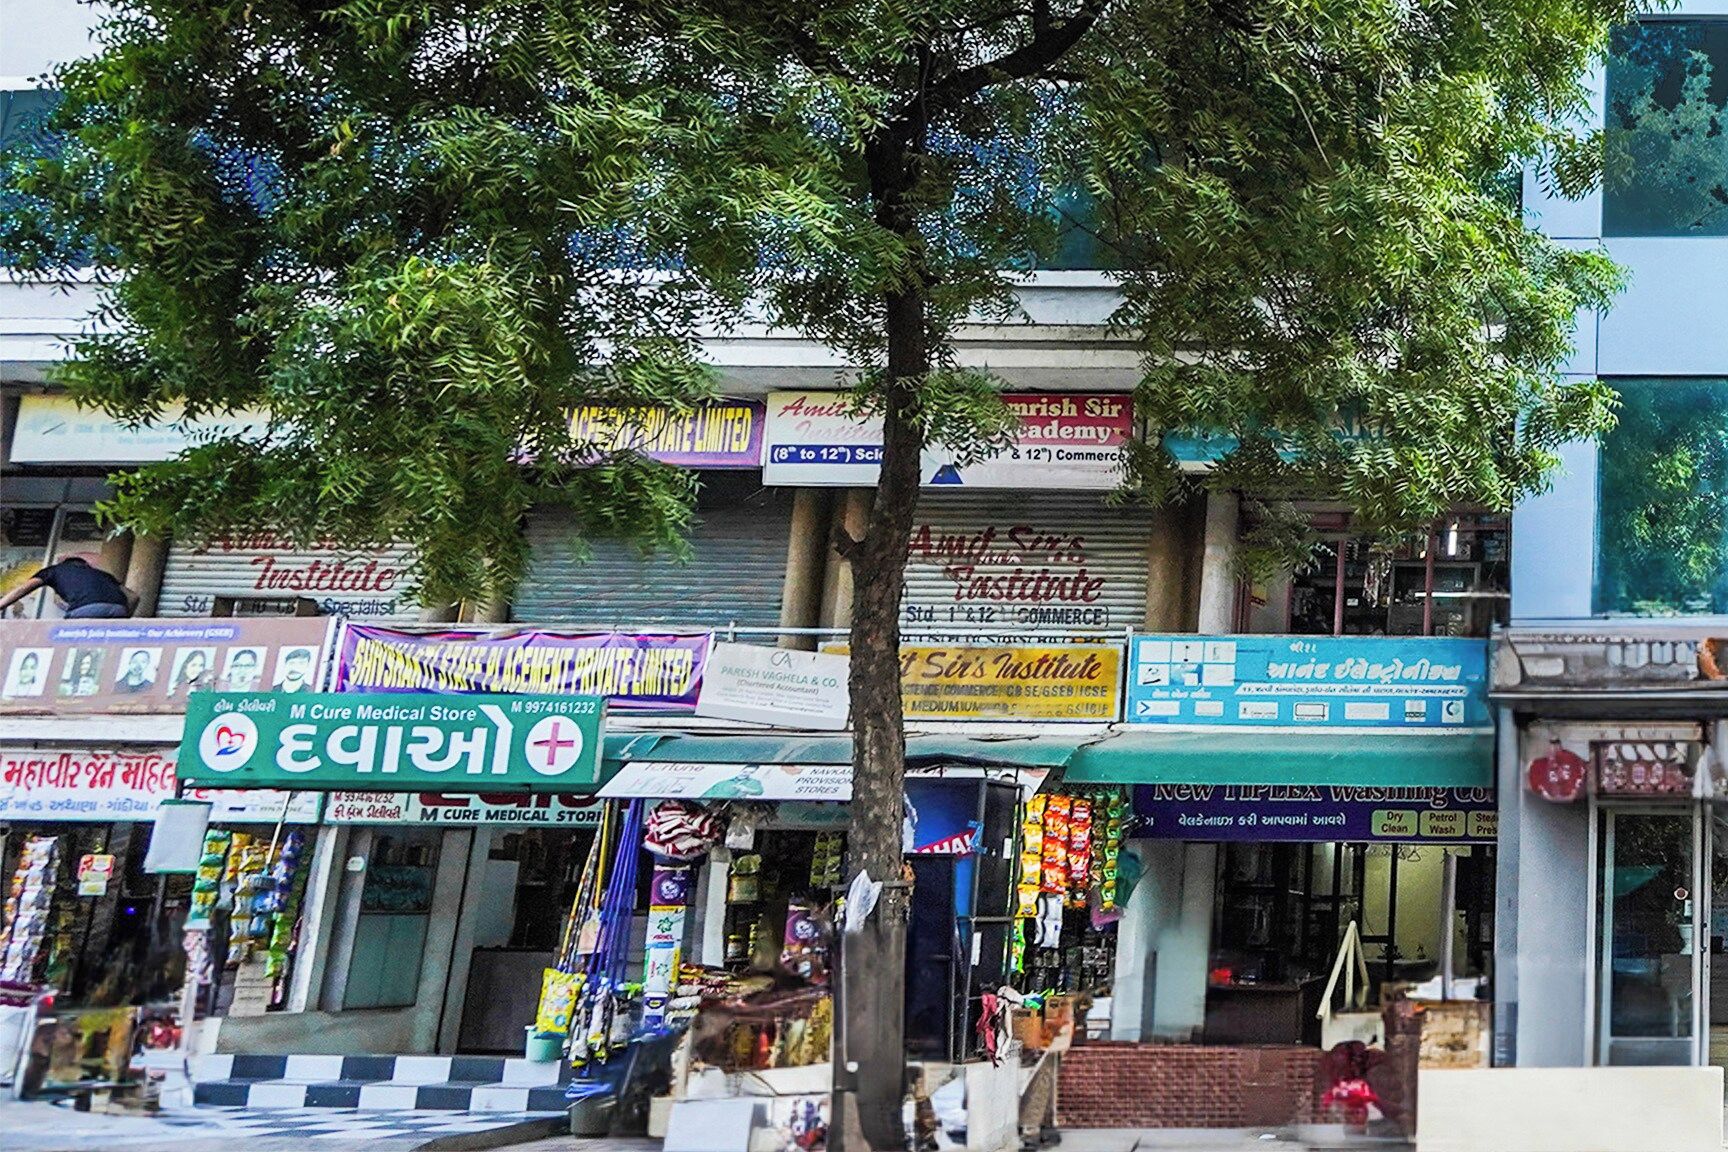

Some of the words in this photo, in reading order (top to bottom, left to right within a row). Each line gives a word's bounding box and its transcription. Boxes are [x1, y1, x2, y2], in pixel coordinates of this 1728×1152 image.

[778, 396, 847, 417] Amit
[1008, 398, 1078, 417] mrish
[1084, 398, 1122, 417] Sir
[694, 407, 751, 452] LIMITED
[801, 448, 816, 460] to
[1011, 449, 1021, 459] &
[1056, 449, 1126, 461] Commerce
[908, 524, 996, 562] Amit
[252, 556, 396, 592] Institute
[945, 564, 1106, 602] Institute
[906, 606, 937, 622] Std.
[482, 646, 573, 694] PLACEMENT
[574, 647, 631, 694] PRIVATE
[632, 647, 694, 696] LIMITED
[922, 651, 987, 679] Sir's
[993, 652, 1101, 680] Institute
[721, 666, 760, 679] PARESH
[763, 670, 808, 684] VAGHELA
[290, 704, 306, 718] M
[310, 705, 353, 720] Cure
[356, 705, 425, 721] Medical
[429, 707, 477, 721] Store
[511, 702, 523, 713] M
[525, 701, 595, 715] 9974161232
[274, 704, 513, 775] દવાઓ
[1329, 785, 1449, 809] Washing
[420, 808, 437, 821] M
[443, 809, 480, 821] CURE
[485, 808, 549, 821] MEDICAL
[556, 810, 602, 822] STOR
[1387, 811, 1404, 823] Dry
[1429, 812, 1457, 823] Petrol
[1381, 825, 1408, 833] Clean
[1430, 825, 1456, 835] Wash
